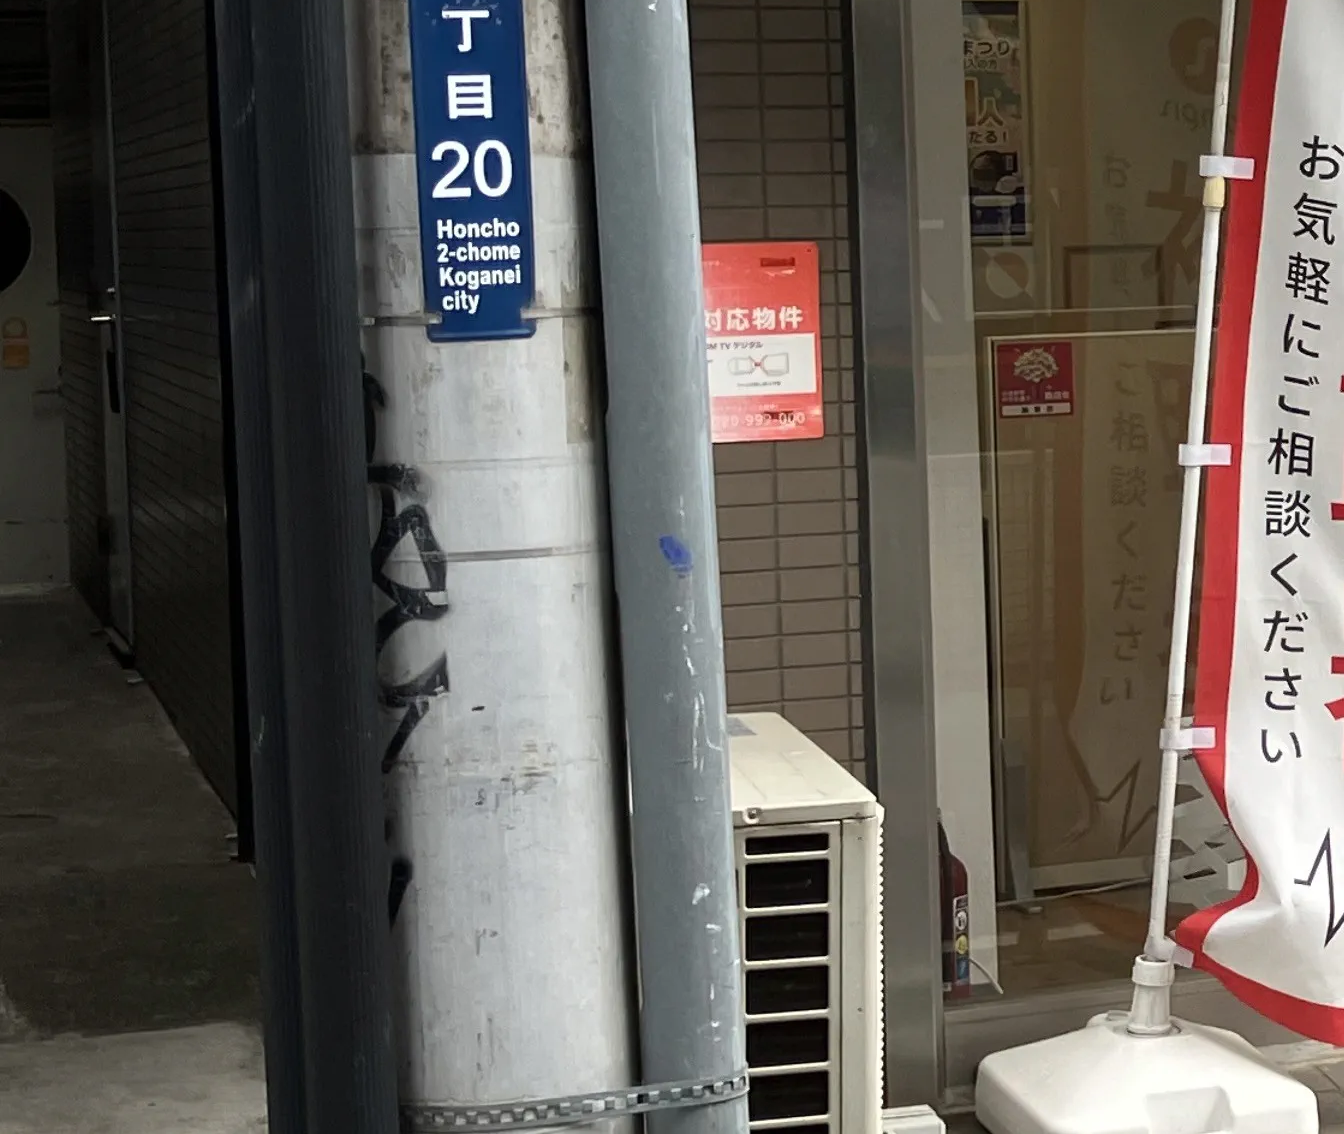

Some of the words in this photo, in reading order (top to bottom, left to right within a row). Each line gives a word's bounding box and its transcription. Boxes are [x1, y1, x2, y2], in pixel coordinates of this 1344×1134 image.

[431, 139, 513, 199] 20
[437, 219, 520, 238] Honcho
[437, 243, 521, 262] 2-chome
[439, 266, 522, 290] Koganei
[442, 292, 481, 314] city
[1261, 135, 1344, 762] お気軽にご相談ください
